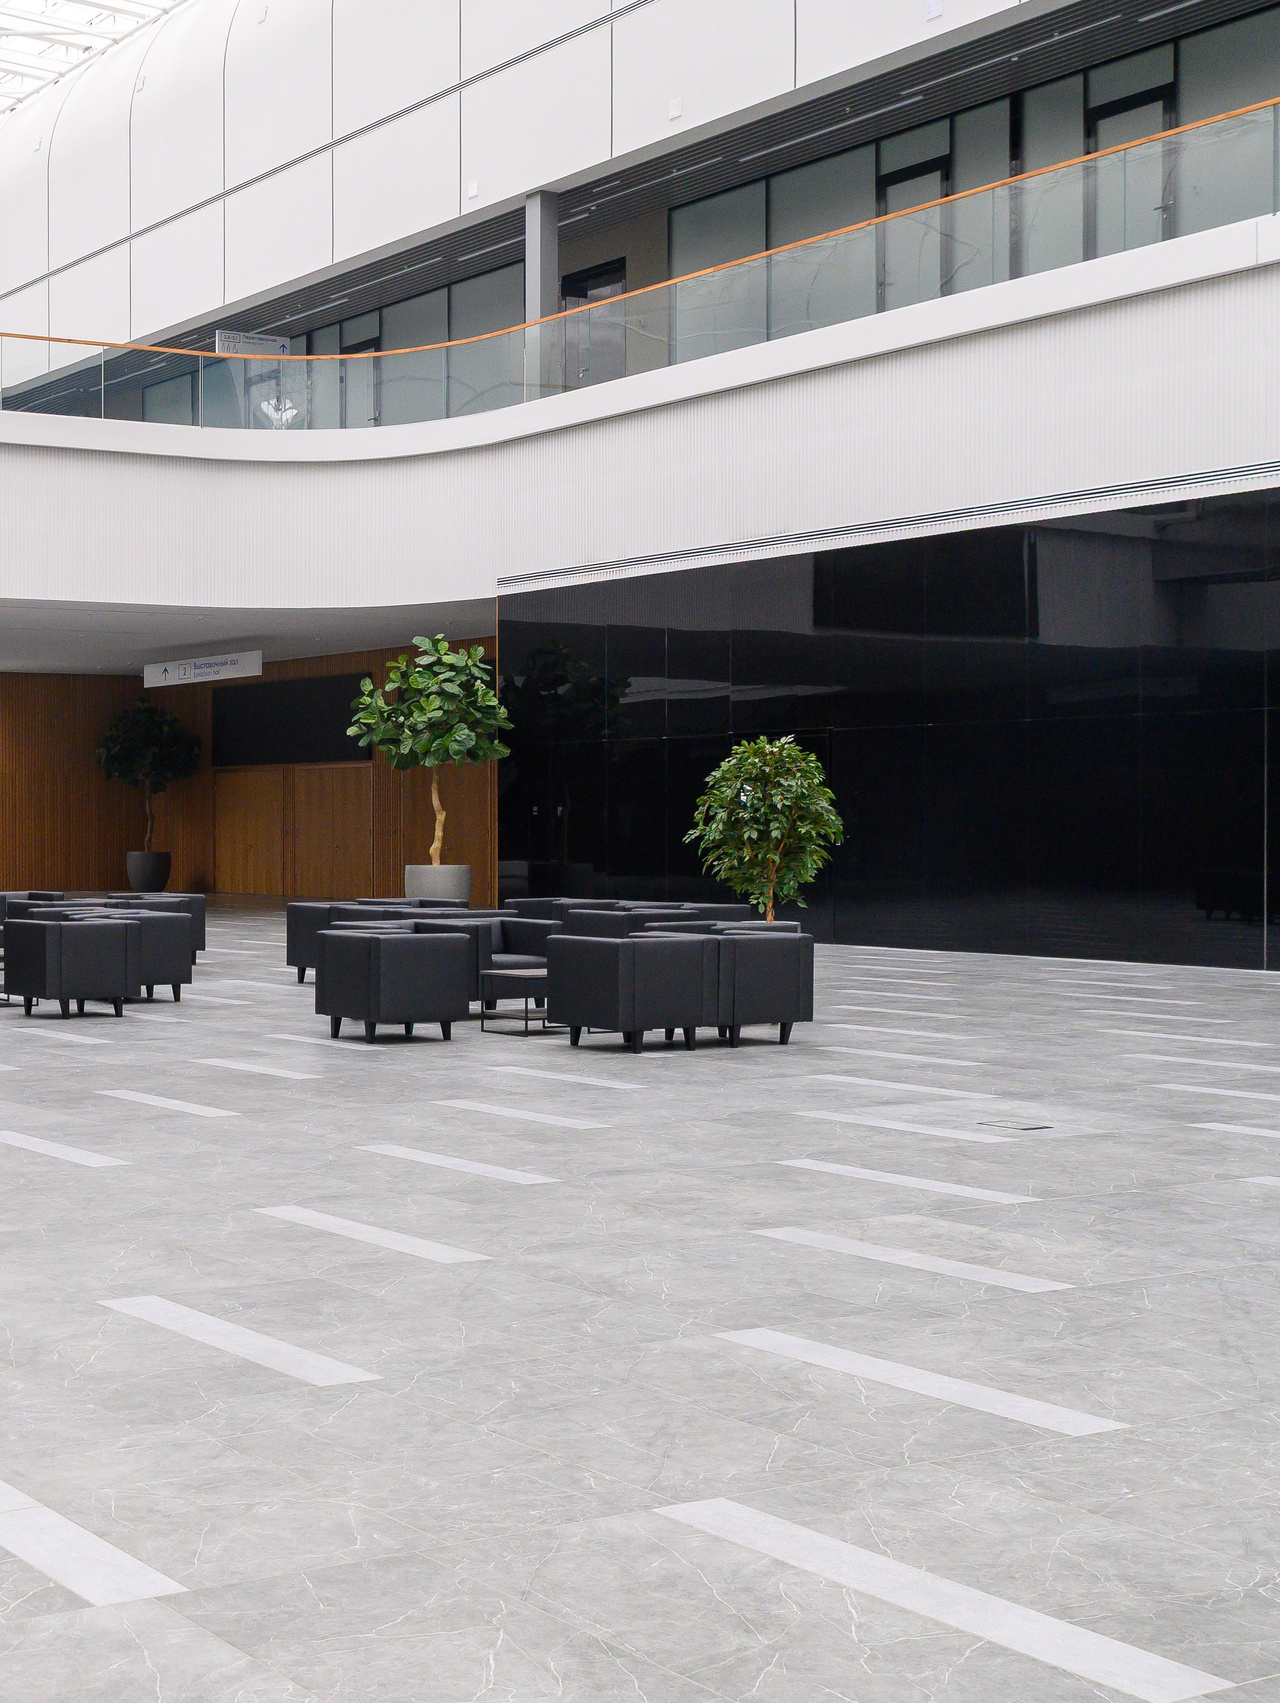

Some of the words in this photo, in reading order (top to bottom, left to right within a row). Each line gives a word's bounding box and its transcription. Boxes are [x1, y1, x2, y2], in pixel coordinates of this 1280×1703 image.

[243, 334, 277, 343] Переговорная
[193, 658, 228, 671] Выставочный
[229, 658, 239, 666] зал
